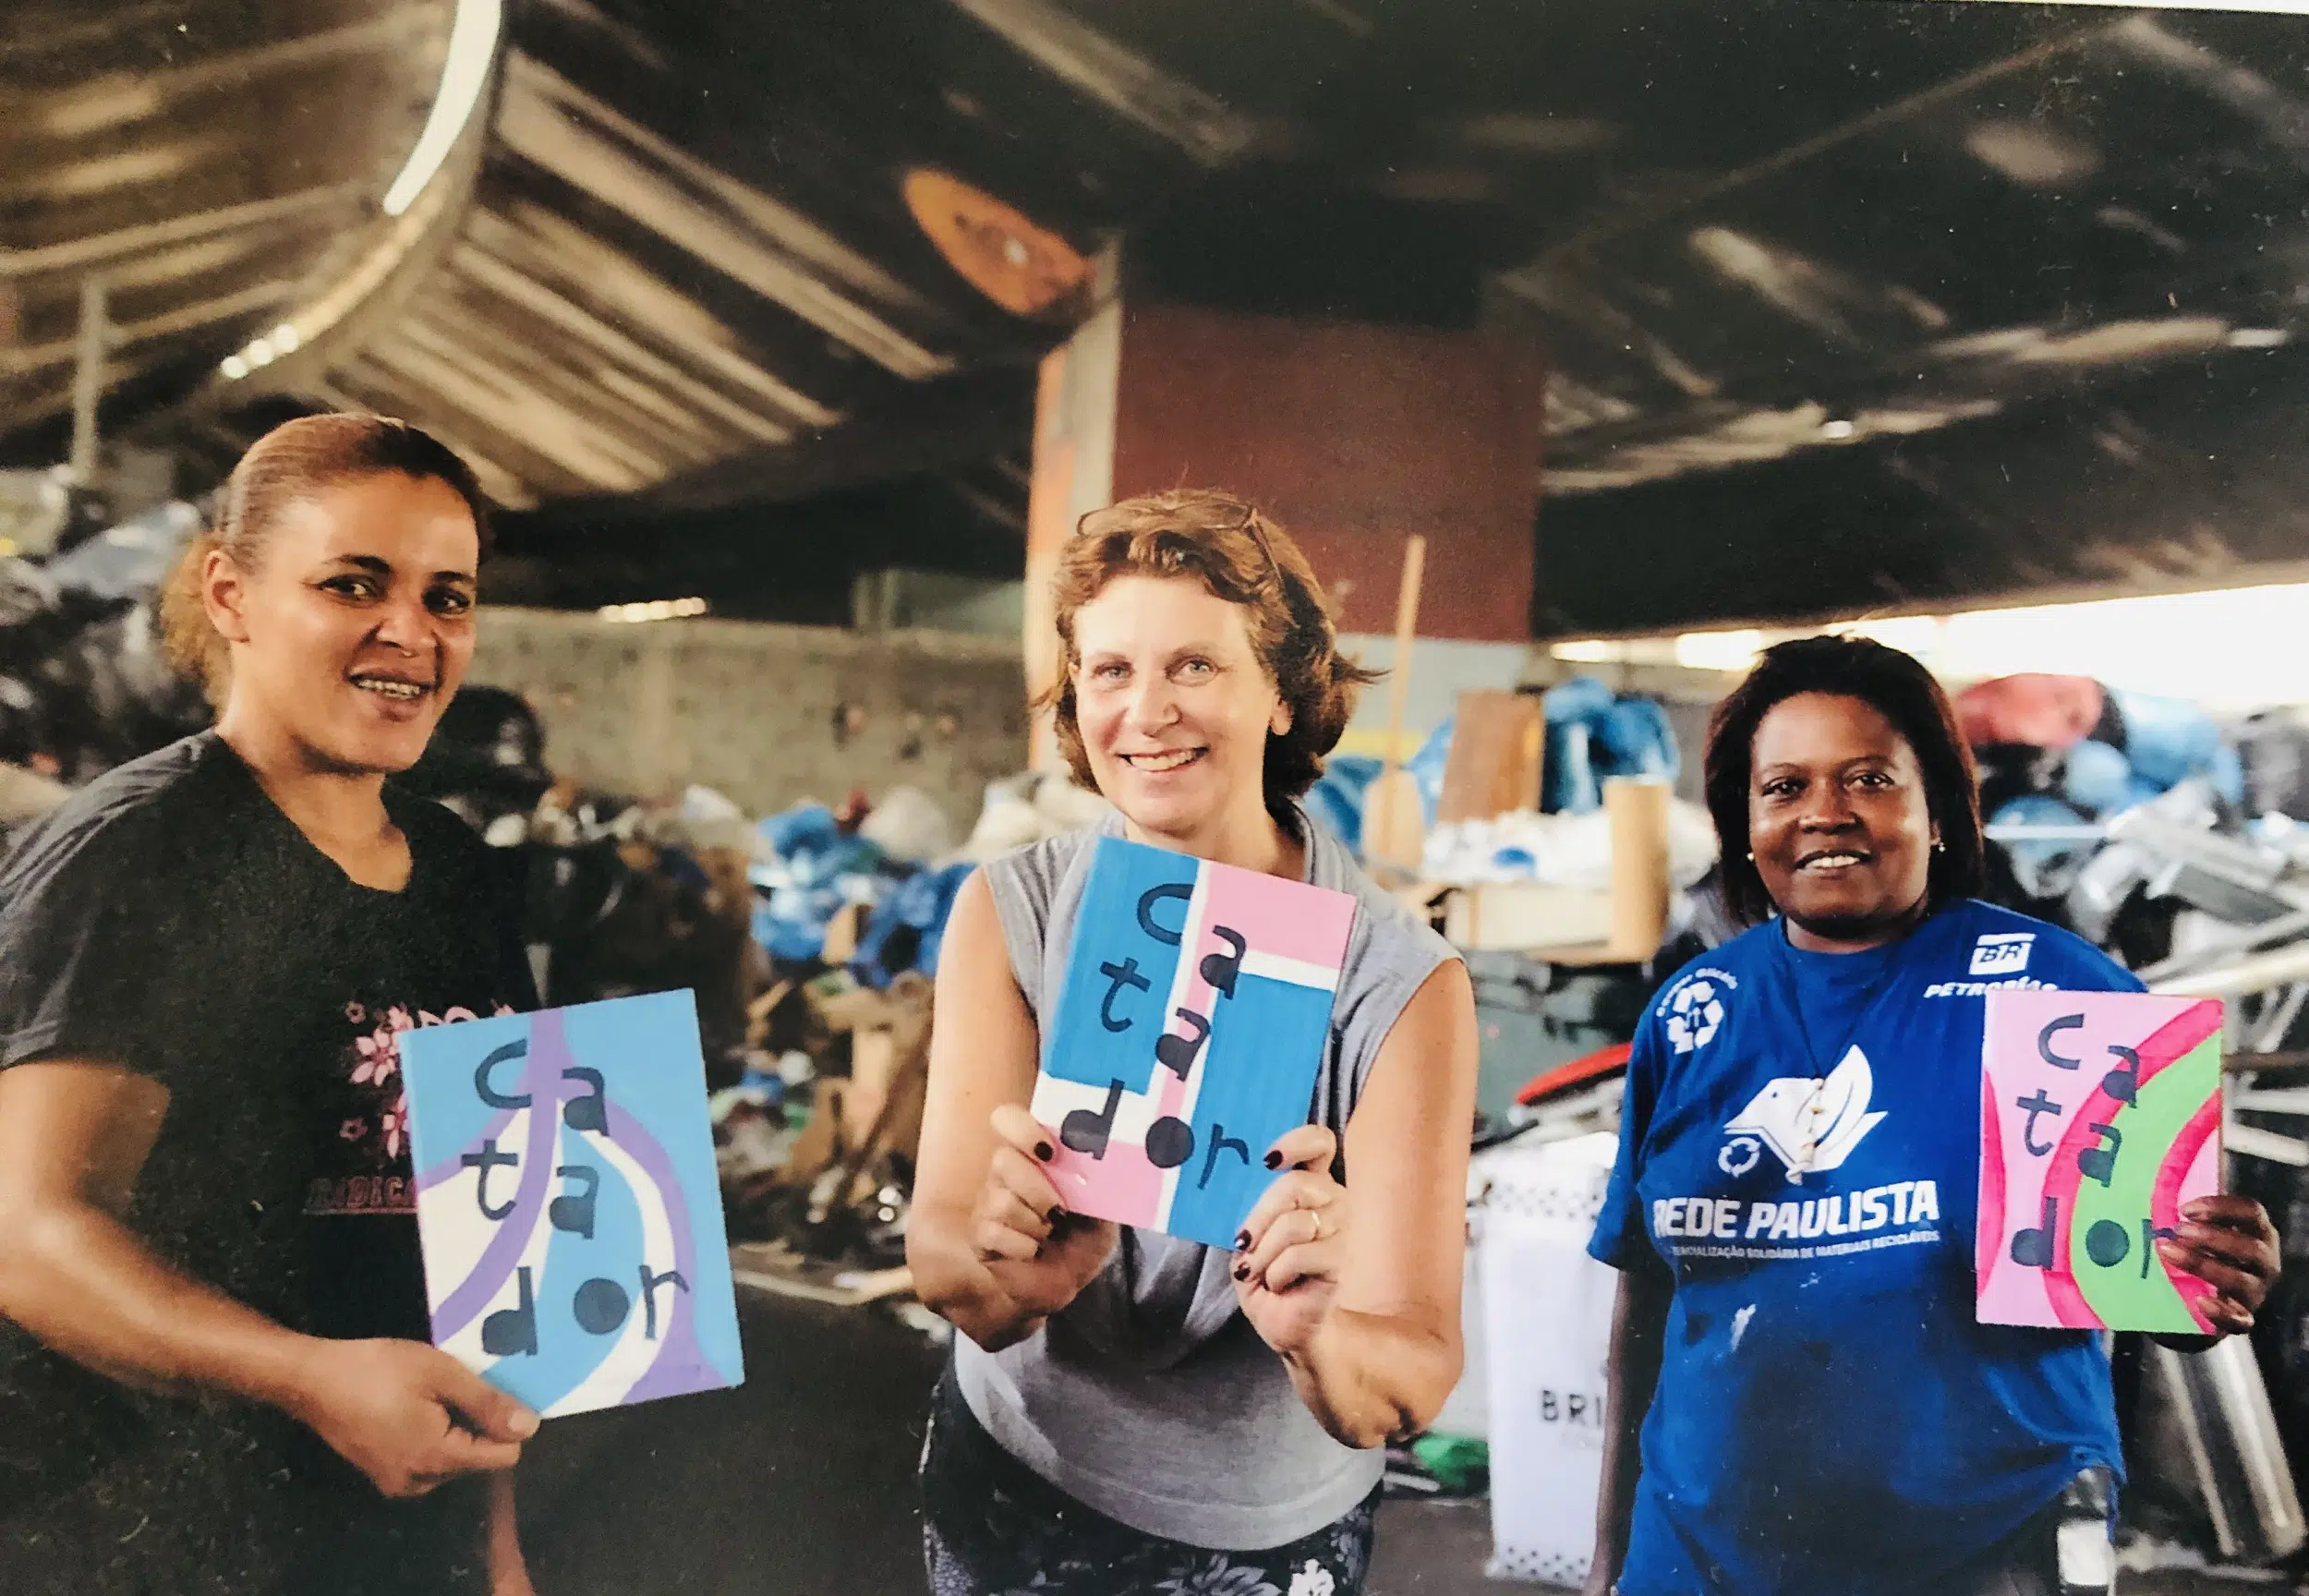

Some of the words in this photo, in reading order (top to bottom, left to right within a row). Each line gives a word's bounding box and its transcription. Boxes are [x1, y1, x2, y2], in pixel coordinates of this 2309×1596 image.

[1979, 942, 2021, 963] BR
[1099, 957, 1212, 1082] ta
[1060, 1079, 1250, 1190] dor
[2015, 1089, 2122, 1188] ta
[461, 1139, 598, 1239] ta
[1745, 1179, 1940, 1239] PAULISTA
[482, 1264, 690, 1357] dor
